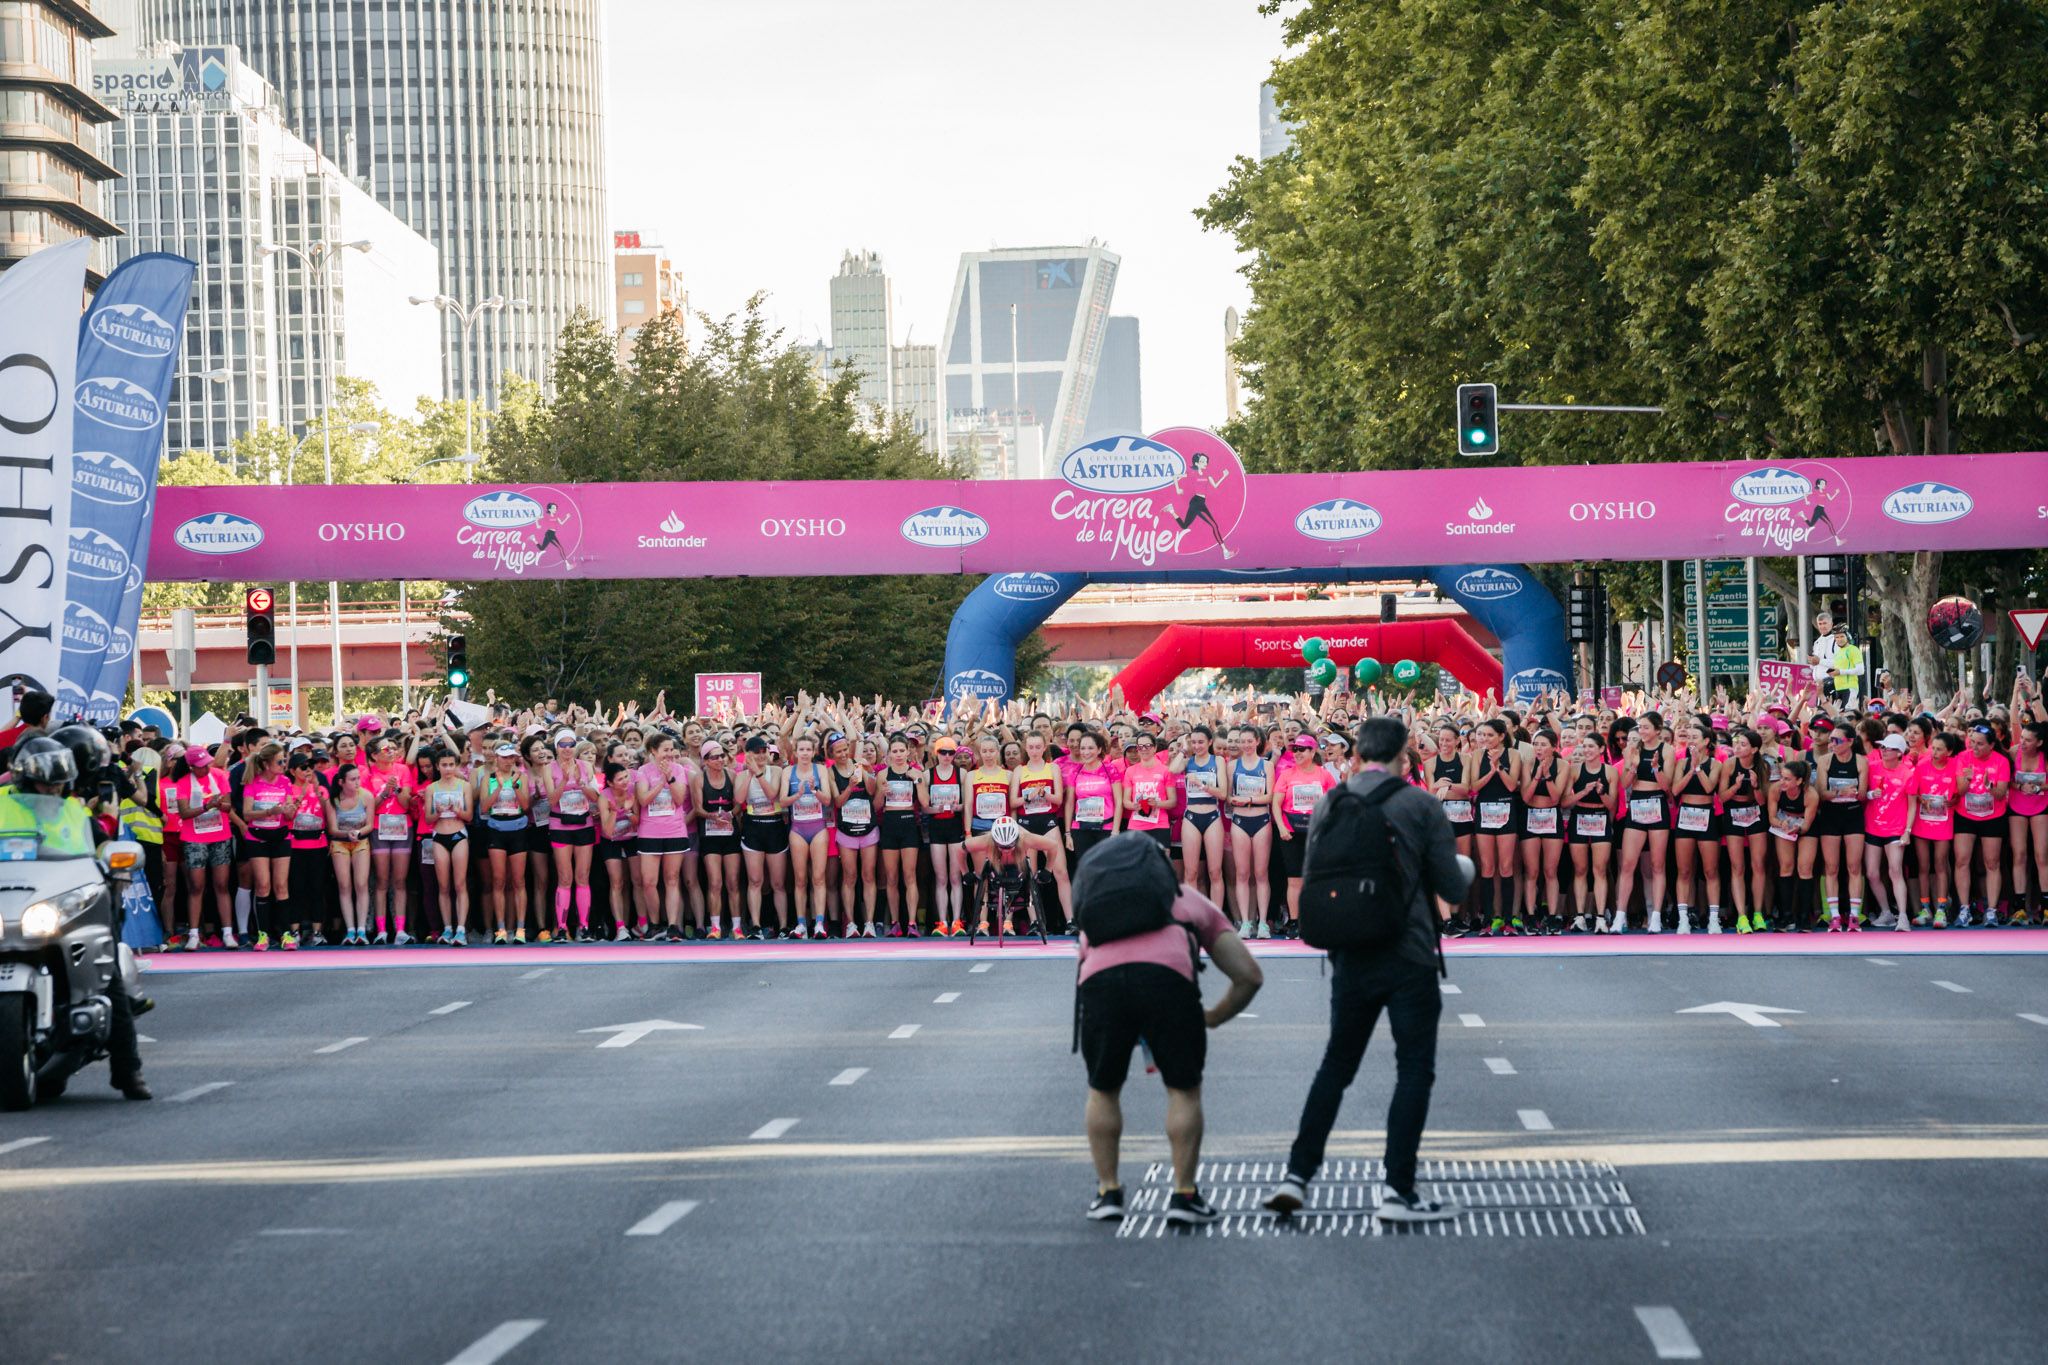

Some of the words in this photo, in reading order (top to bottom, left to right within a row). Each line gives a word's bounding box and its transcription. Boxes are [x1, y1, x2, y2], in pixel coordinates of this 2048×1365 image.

[127, 88, 231, 102] BancaMarch
[95, 314, 171, 350] ASTURIANA
[78, 386, 154, 424] ASTURIANA
[1071, 457, 1175, 479] ASTURIANA
[74, 470, 140, 498] STURIANA
[1738, 483, 1805, 497] ASTURIANA
[470, 505, 536, 519] ASTURIANA
[1051, 489, 1153, 521] Carrera
[1569, 500, 1656, 521] OYSHO
[1724, 502, 1791, 523] Carrera
[1890, 498, 1966, 513] ASTURIANA
[760, 518, 846, 537] OYSHO
[908, 521, 982, 537] ASTURIANA
[1302, 514, 1375, 531] ASTURIANA
[1446, 521, 1516, 536] Santander
[183, 527, 256, 543] ASTURIANA
[318, 522, 405, 541] OYSHO
[456, 525, 522, 545] Carrera
[1740, 523, 1753, 536] de
[1756, 523, 1765, 536] la
[1763, 518, 1815, 551] Mujer
[638, 535, 708, 548] Santander
[1076, 520, 1095, 542] de
[1099, 521, 1112, 542] la
[1110, 515, 1191, 566] Mujer
[69, 549, 122, 574] URIANA
[472, 545, 486, 559] de
[488, 545, 497, 559] la
[494, 542, 546, 574] Mujer
[1000, 580, 1054, 593] ASTURIANA
[1461, 580, 1518, 593] ASTURIANA
[1709, 592, 1748, 602] Argentin
[1254, 638, 1292, 652] Sports
[1709, 639, 1749, 648] Villaverd
[1721, 663, 1749, 671] Camin
[1761, 664, 1791, 679] SUB
[706, 679, 734, 692] SUB
